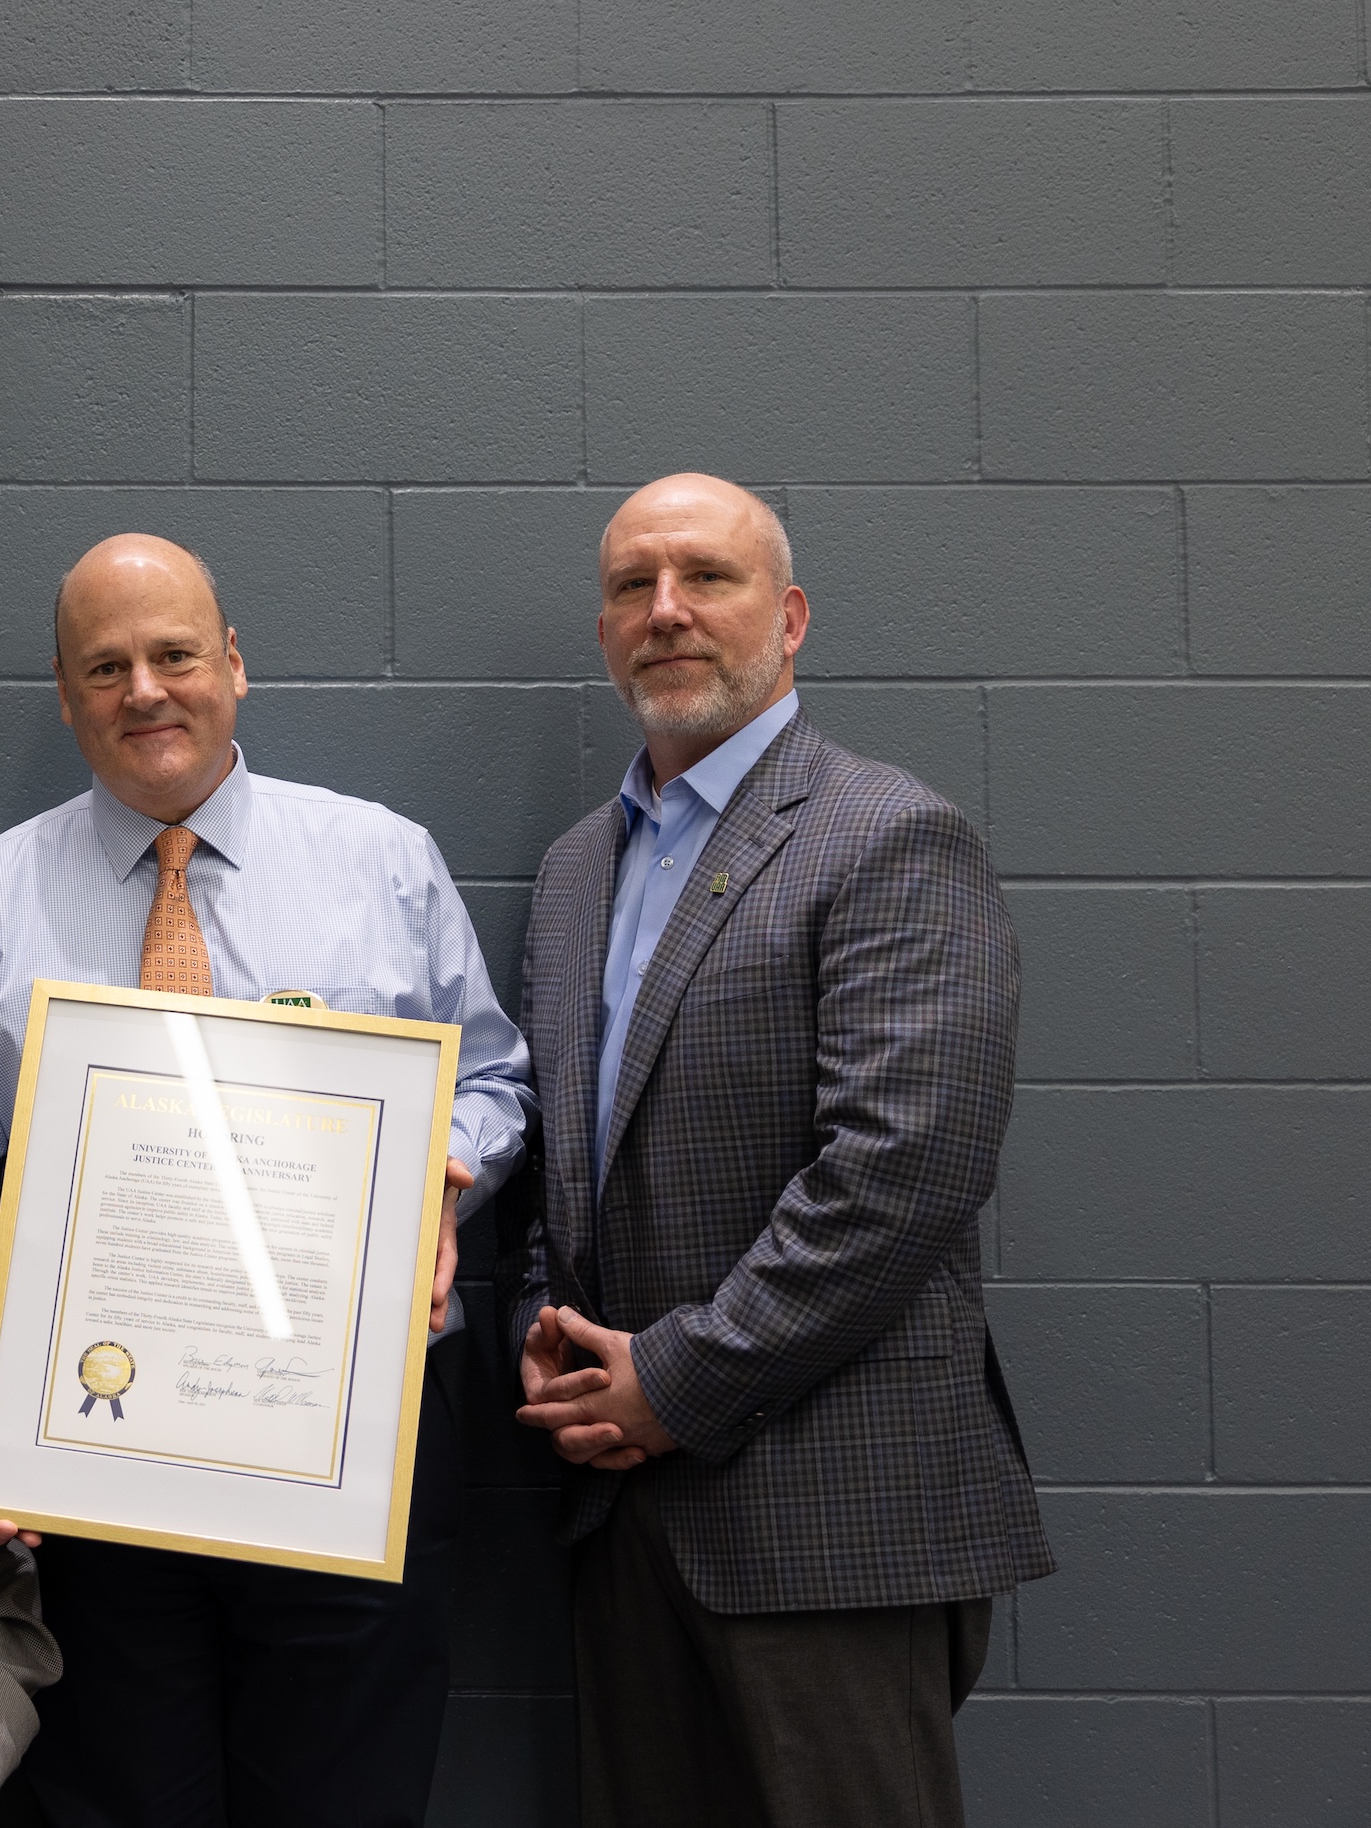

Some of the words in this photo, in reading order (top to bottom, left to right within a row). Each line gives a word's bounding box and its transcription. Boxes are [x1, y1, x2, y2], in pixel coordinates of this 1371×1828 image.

[113, 1091, 198, 1116] ALASKA
[218, 1103, 348, 1134] EGISLATURE
[131, 1143, 192, 1157] UNIVERSITY
[193, 1150, 207, 1159] OF
[252, 1156, 317, 1172] ANCHORAGE
[132, 1153, 174, 1166] JUSTICE
[241, 1166, 312, 1183] ANNIVERSARY
